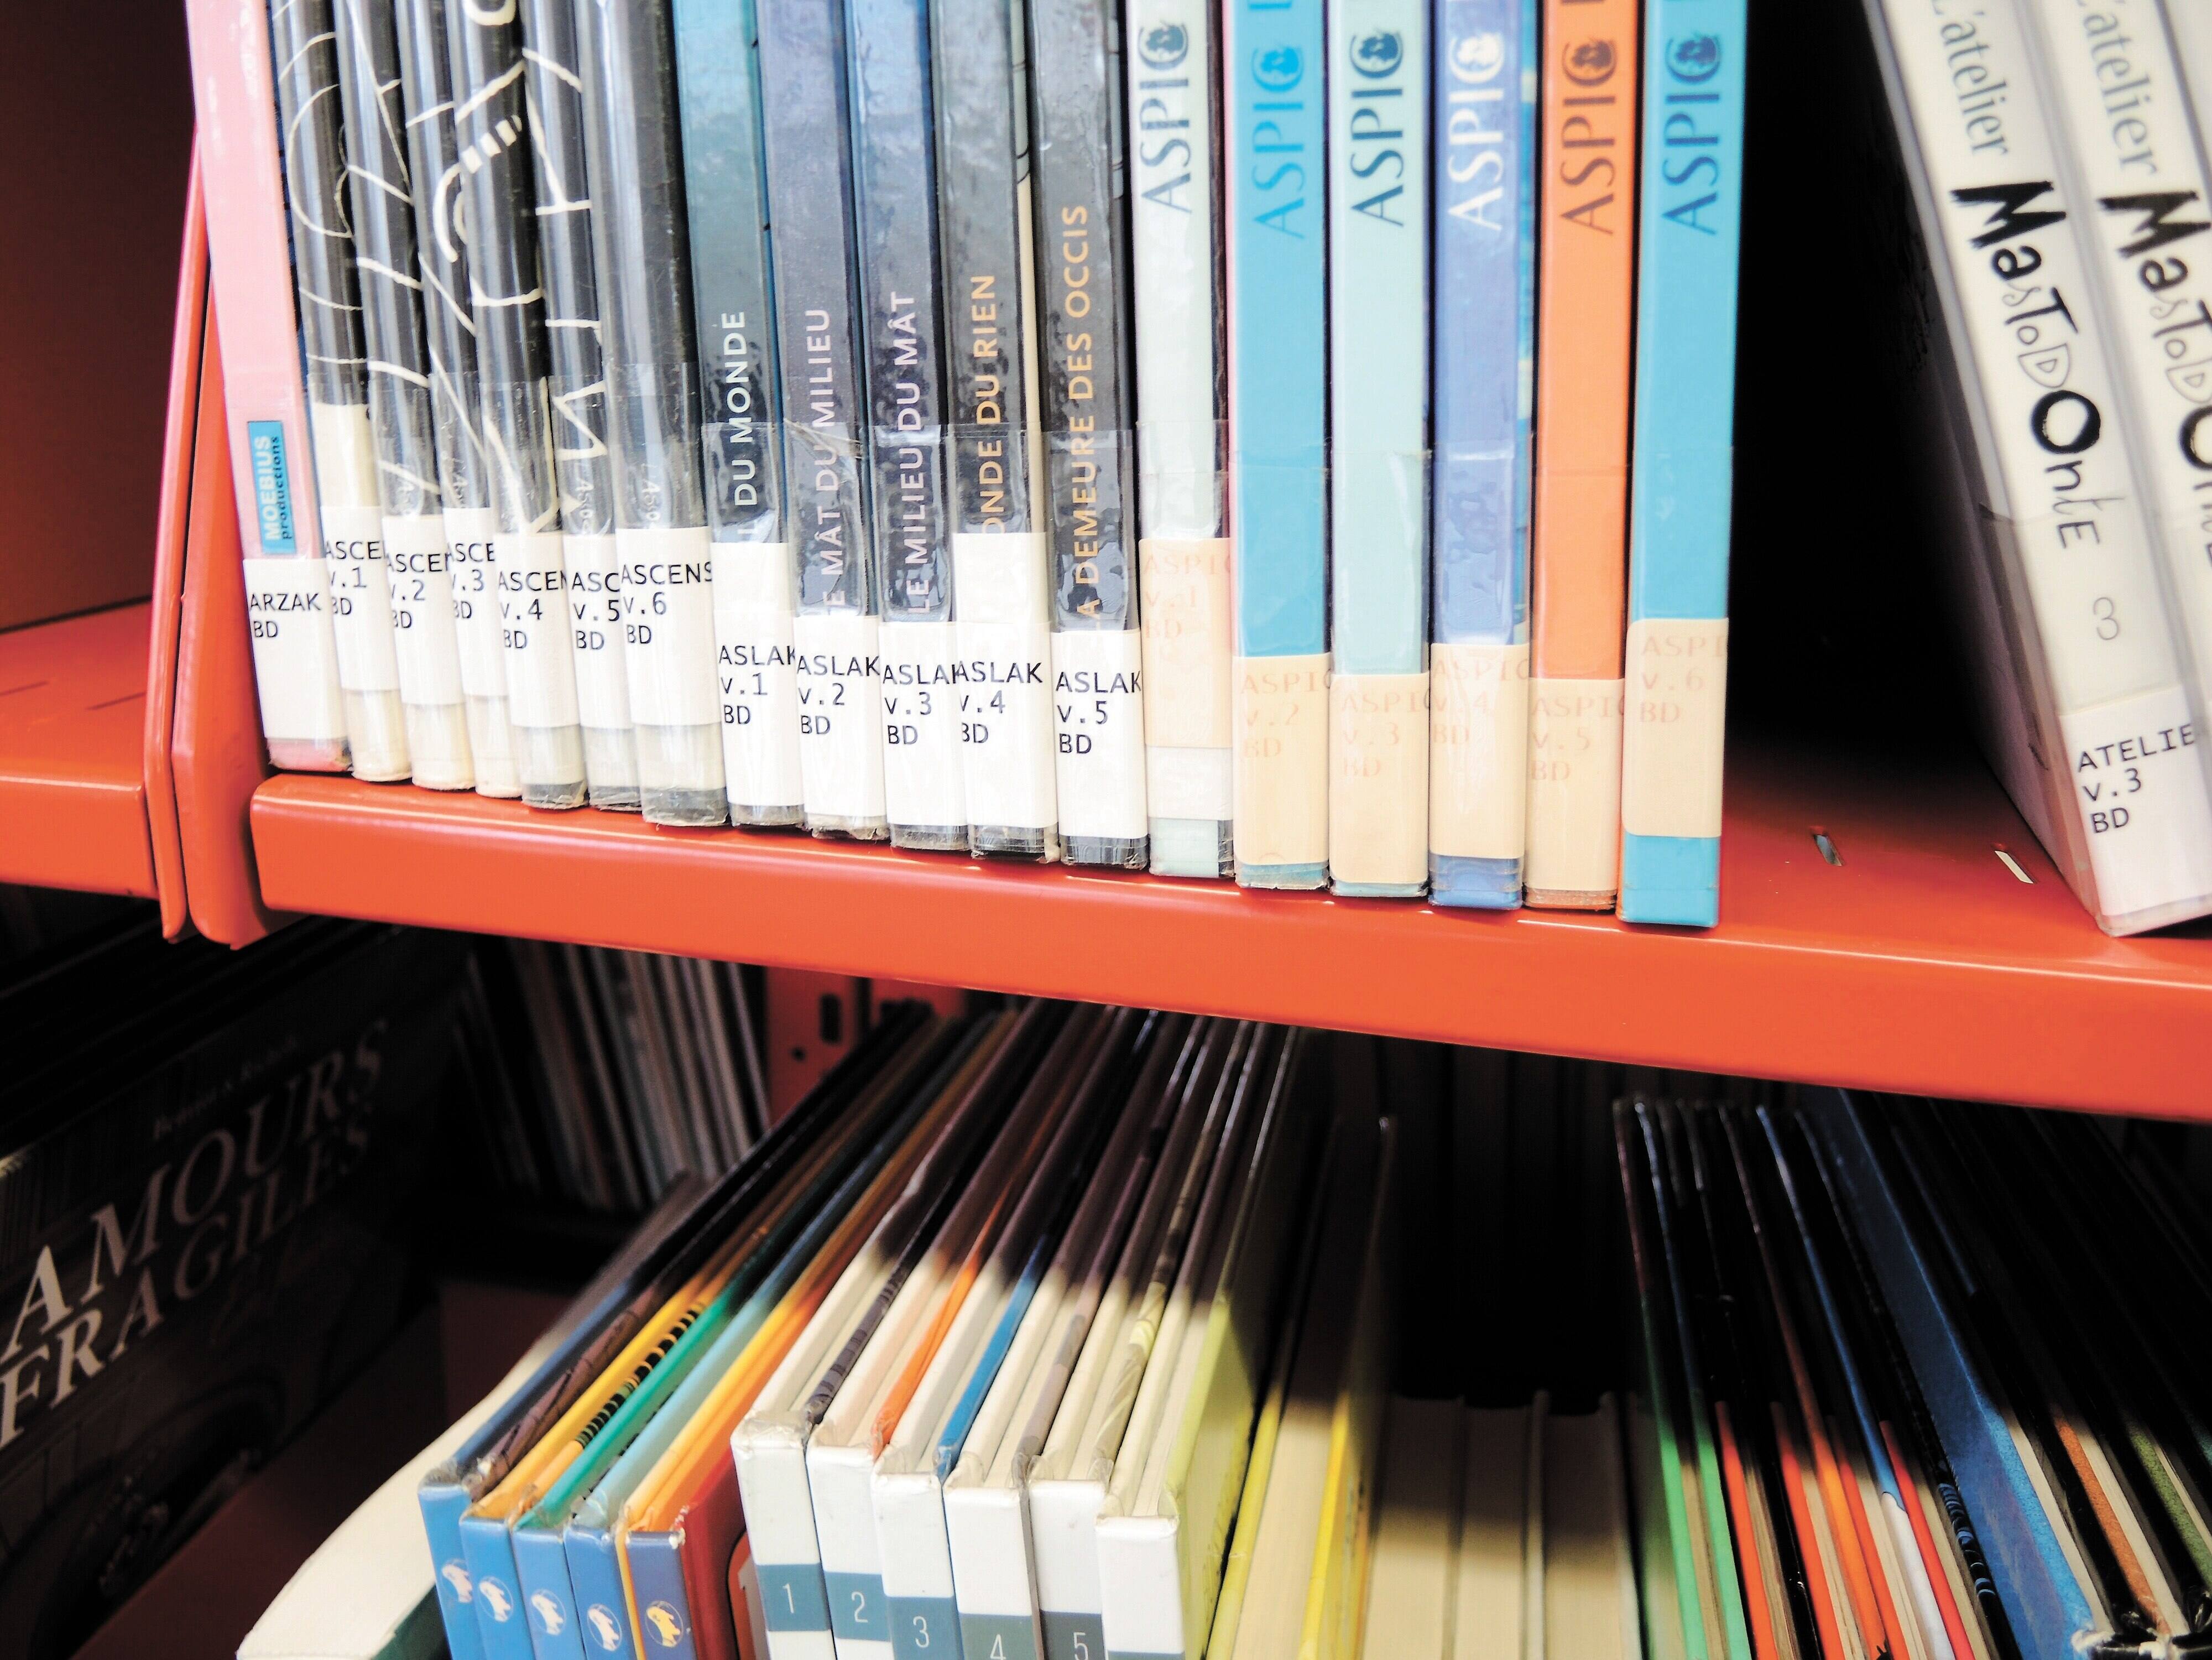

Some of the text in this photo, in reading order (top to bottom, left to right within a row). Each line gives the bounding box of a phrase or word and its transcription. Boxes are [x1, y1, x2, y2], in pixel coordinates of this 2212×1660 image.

[1137, 22, 1192, 214] ASPIC
[1349, 29, 1404, 227] ASPIC
[1447, 32, 1505, 231] ASPIC
[1251, 46, 1305, 240] ASPIC
[1559, 38, 1618, 236] ASPIC
[1662, 33, 1721, 236] ASPIC
[1063, 205, 1089, 318] OCCIS
[971, 275, 999, 358] RIEN
[721, 311, 753, 443] MONDE
[805, 310, 835, 426] MILIEU
[1067, 332, 1093, 400] DES
[975, 374, 1001, 425] DU
[815, 445, 839, 492] DU
[888, 292, 930, 614] LE MILIEU DU MÂT
[254, 435, 281, 541] MOEBIUS
[271, 436, 293, 540] productions
[732, 459, 758, 506] DU
[1070, 415, 1100, 585] DEMEURE
[814, 505, 844, 576] MÂT
[572, 571, 620, 592] ASC
[250, 592, 322, 612] ARZAK
[253, 620, 279, 639] BD
[627, 624, 652, 644] BD
[2093, 597, 2120, 641] 3
[503, 629, 528, 649] BD
[576, 629, 604, 651] BD
[797, 655, 880, 677] ASLAK
[957, 660, 1043, 684] ASLAK
[1056, 670, 1141, 694] ASLAK
[721, 672, 768, 696] v.1
[799, 683, 845, 706] v.2
[724, 704, 751, 725] BD
[884, 691, 932, 715] v.3
[1057, 700, 1109, 725] v.5
[1640, 701, 1681, 724] BD
[801, 714, 831, 735] BD
[888, 725, 918, 745] BD
[961, 722, 989, 743] BD
[1432, 724, 1470, 745] BD
[1059, 733, 1092, 754] BD
[2078, 723, 2195, 773] ATELIE
[1531, 760, 1571, 781] BD
[2083, 767, 2142, 802] v.3
[2090, 806, 2130, 834] BD
[0, 1019, 389, 1365] AMOURS
[0, 1123, 369, 1449] FRAGILES
[782, 1583, 795, 1614] 1
[851, 1591, 868, 1623] 2
[913, 1616, 930, 1648] 3
[990, 1634, 1007, 1660] 4
[1073, 1632, 1089, 1660] 5
